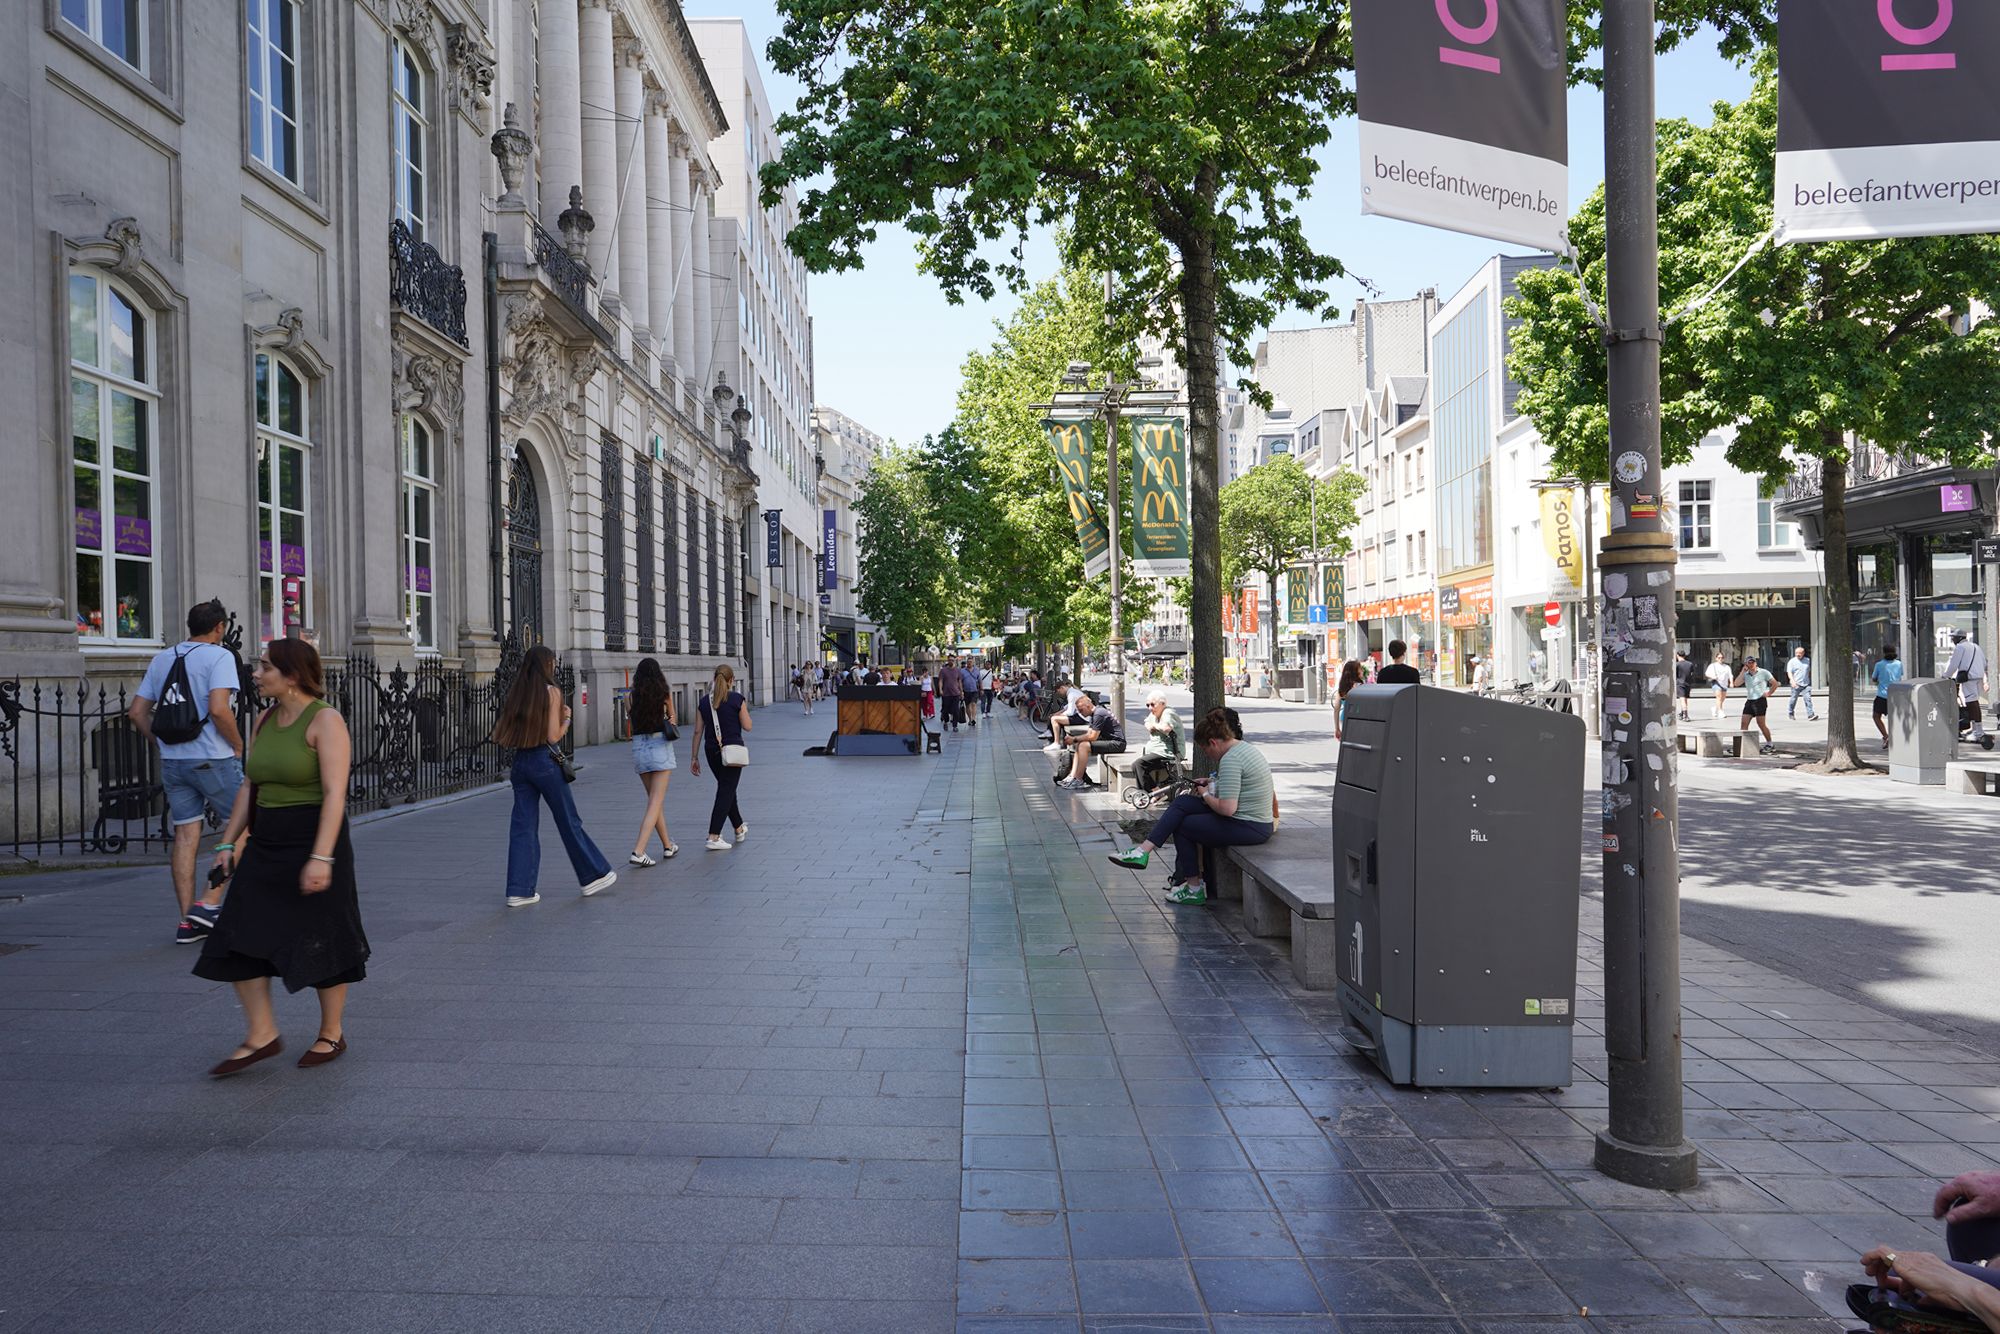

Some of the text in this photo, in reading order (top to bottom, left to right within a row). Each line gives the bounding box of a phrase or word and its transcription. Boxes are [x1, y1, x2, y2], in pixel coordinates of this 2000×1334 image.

[1374, 155, 1558, 216] beleefantwerpen.be
[769, 511, 778, 564] COSTES
[827, 528, 835, 572] Leonidas
[1554, 501, 1573, 568] Panos
[1696, 592, 1785, 608] BERSHKA
[1470, 834, 1488, 842] FILL
